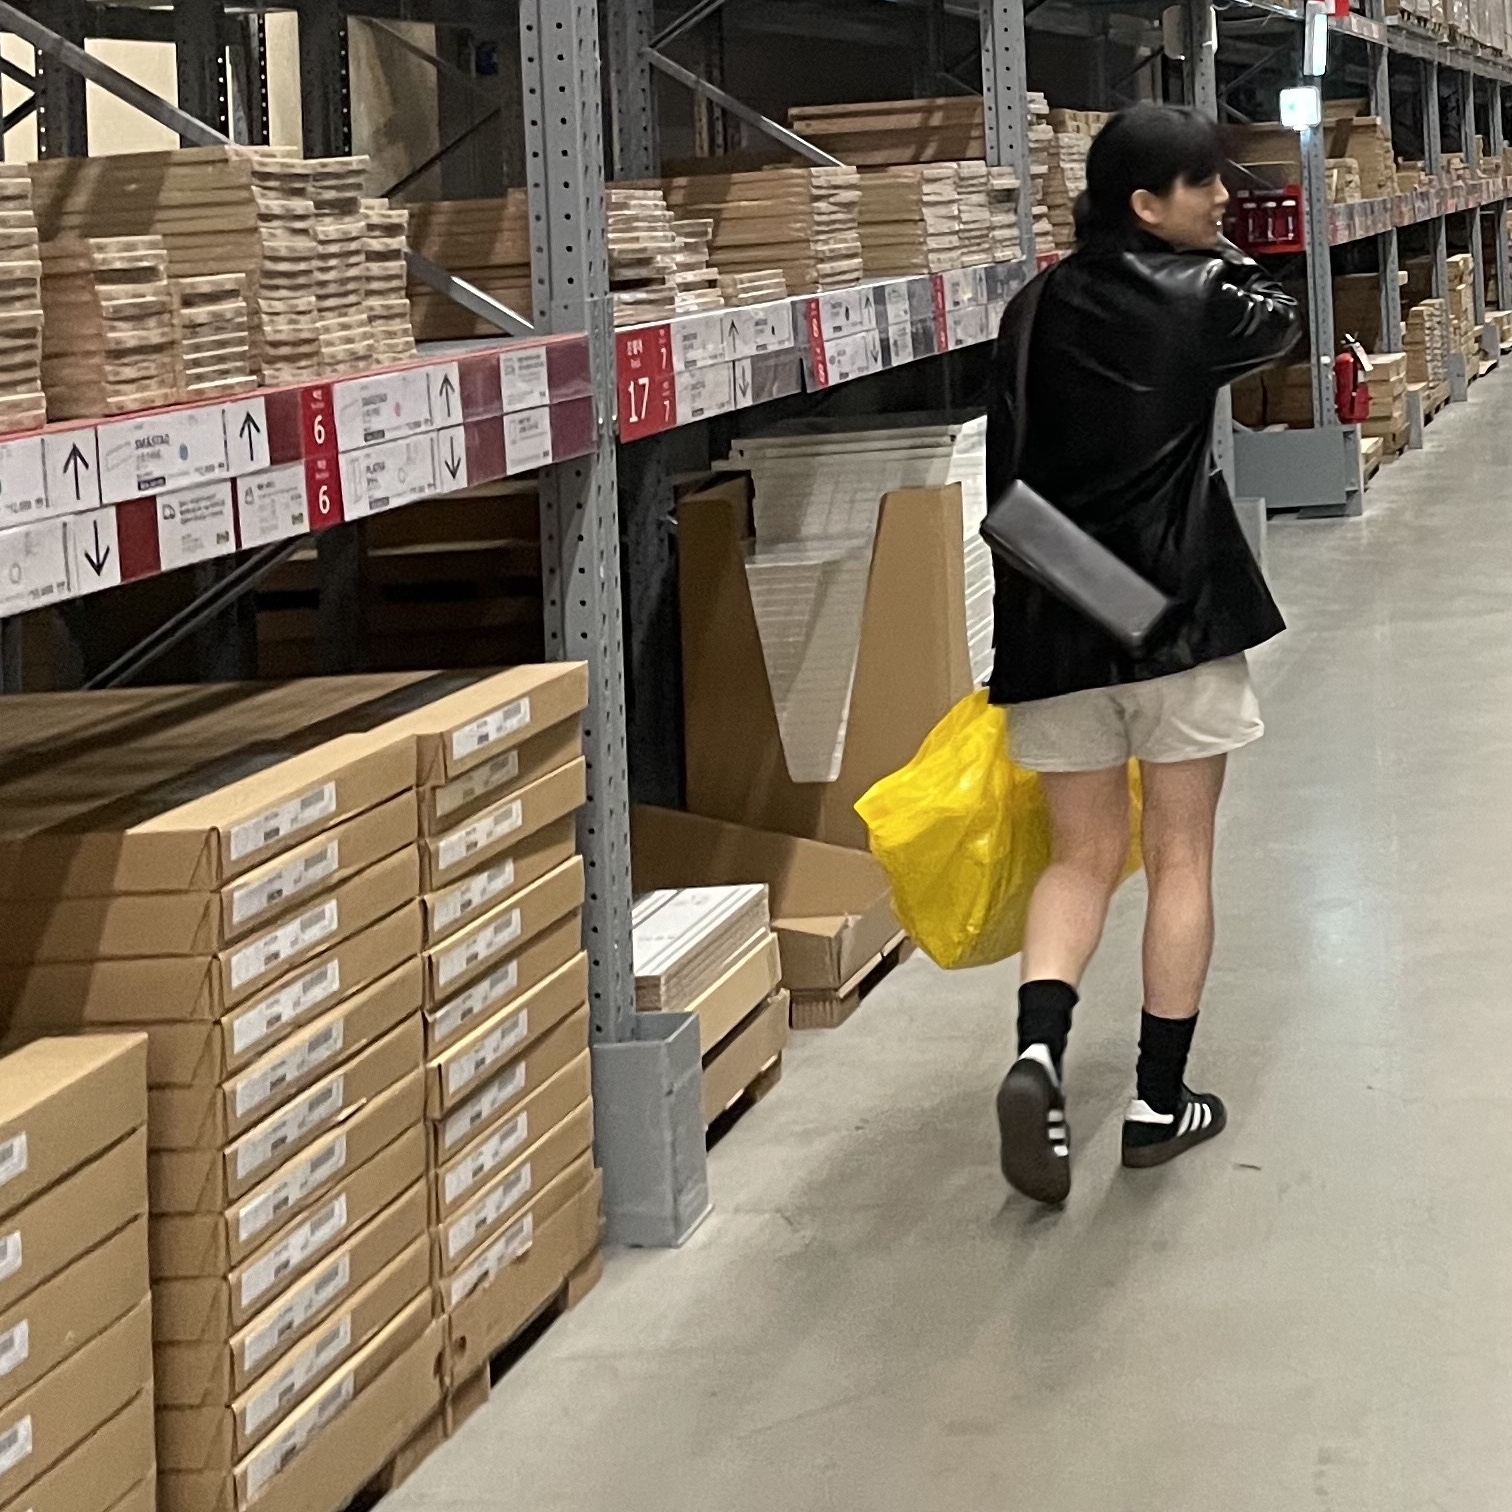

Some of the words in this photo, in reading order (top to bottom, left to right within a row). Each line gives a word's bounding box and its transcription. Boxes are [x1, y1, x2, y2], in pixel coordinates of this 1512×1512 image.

[628, 377, 649, 423] 17
[314, 415, 325, 444] 6
[319, 485, 330, 514] 6
